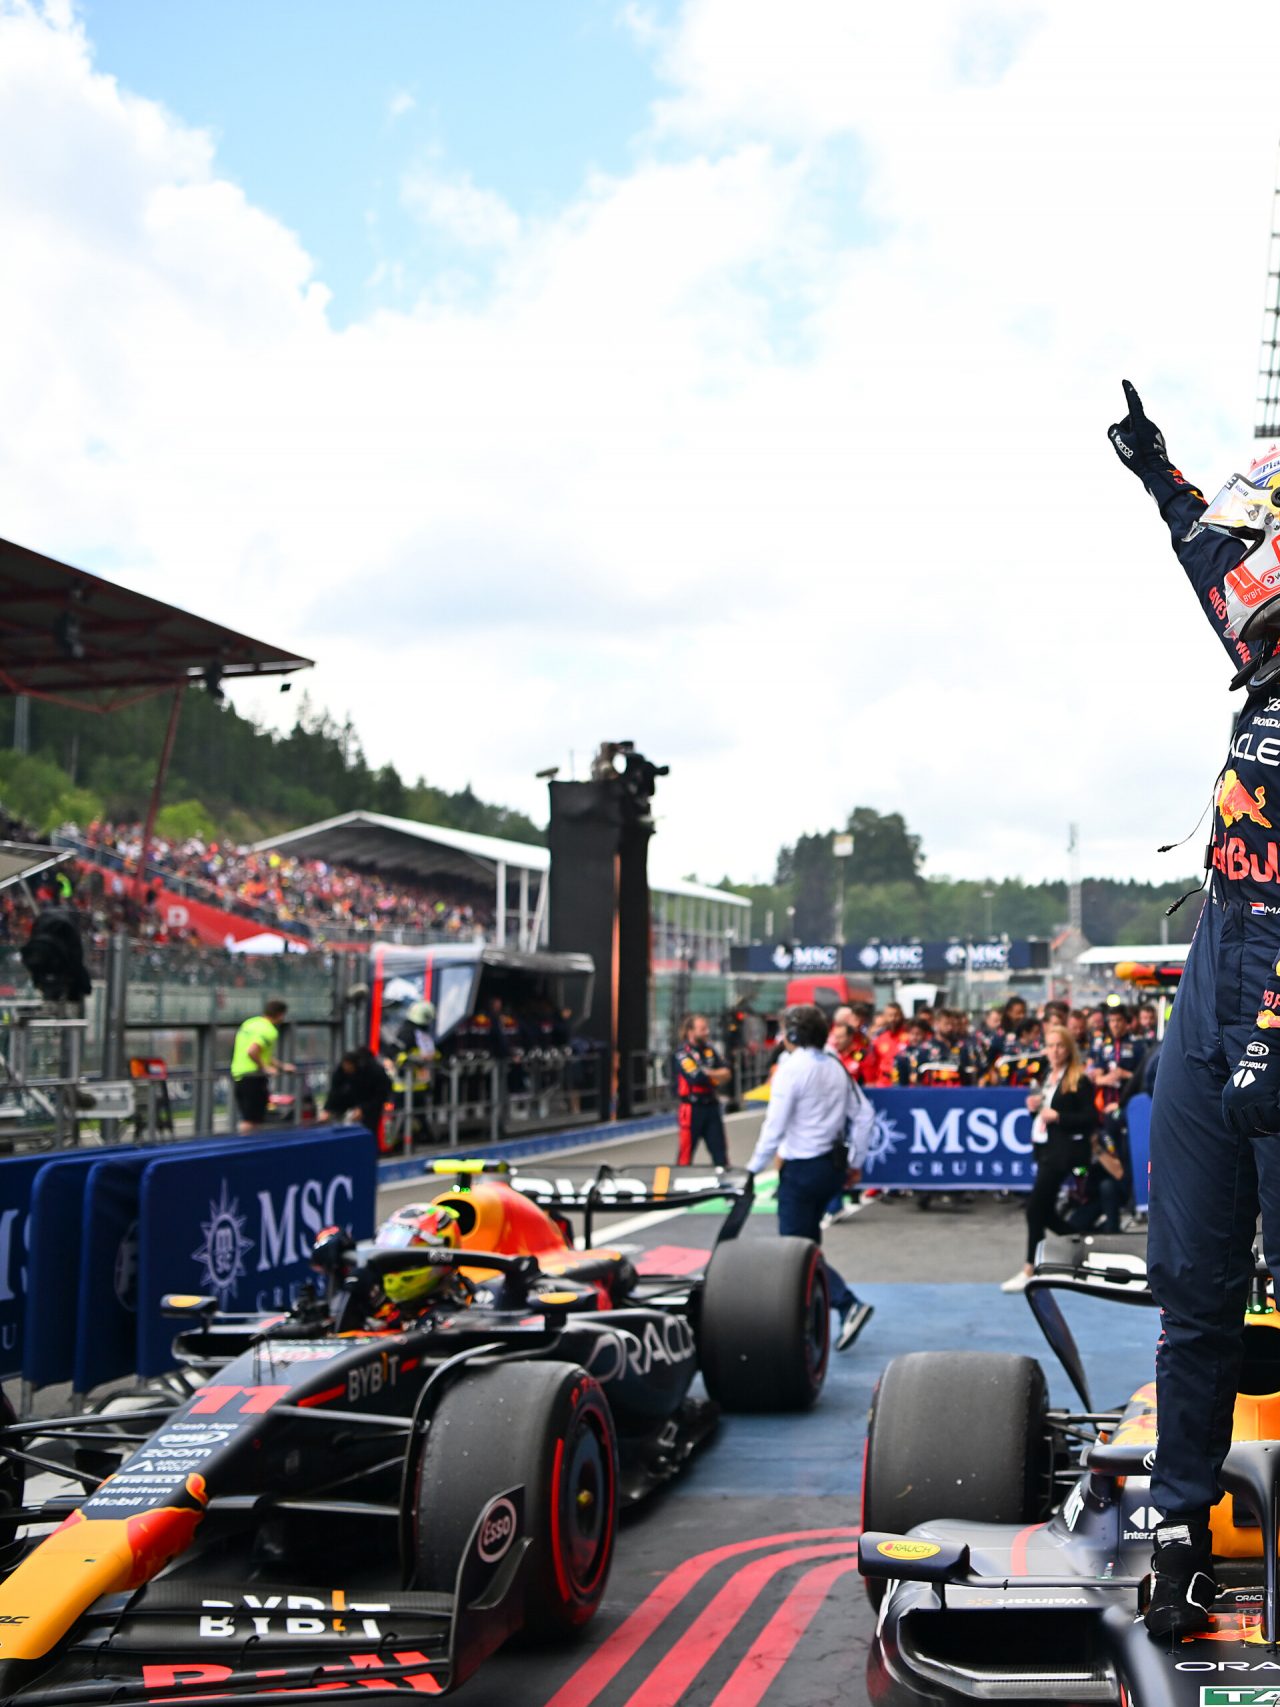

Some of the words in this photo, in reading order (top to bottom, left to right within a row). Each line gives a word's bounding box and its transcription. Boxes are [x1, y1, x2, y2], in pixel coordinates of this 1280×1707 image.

[909, 1107, 1035, 1154] MSC
[908, 1160, 1039, 1177] CRUISES
[256, 1174, 354, 1273] MSC
[347, 1351, 400, 1403] BYBIT
[190, 1386, 292, 1414] 11
[141, 1449, 212, 1458] zoom
[87, 1498, 144, 1507] Mobil
[1123, 1530, 1157, 1540] inter.
[893, 1543, 933, 1554] RAUCH
[1235, 1594, 1264, 1602] ORACL
